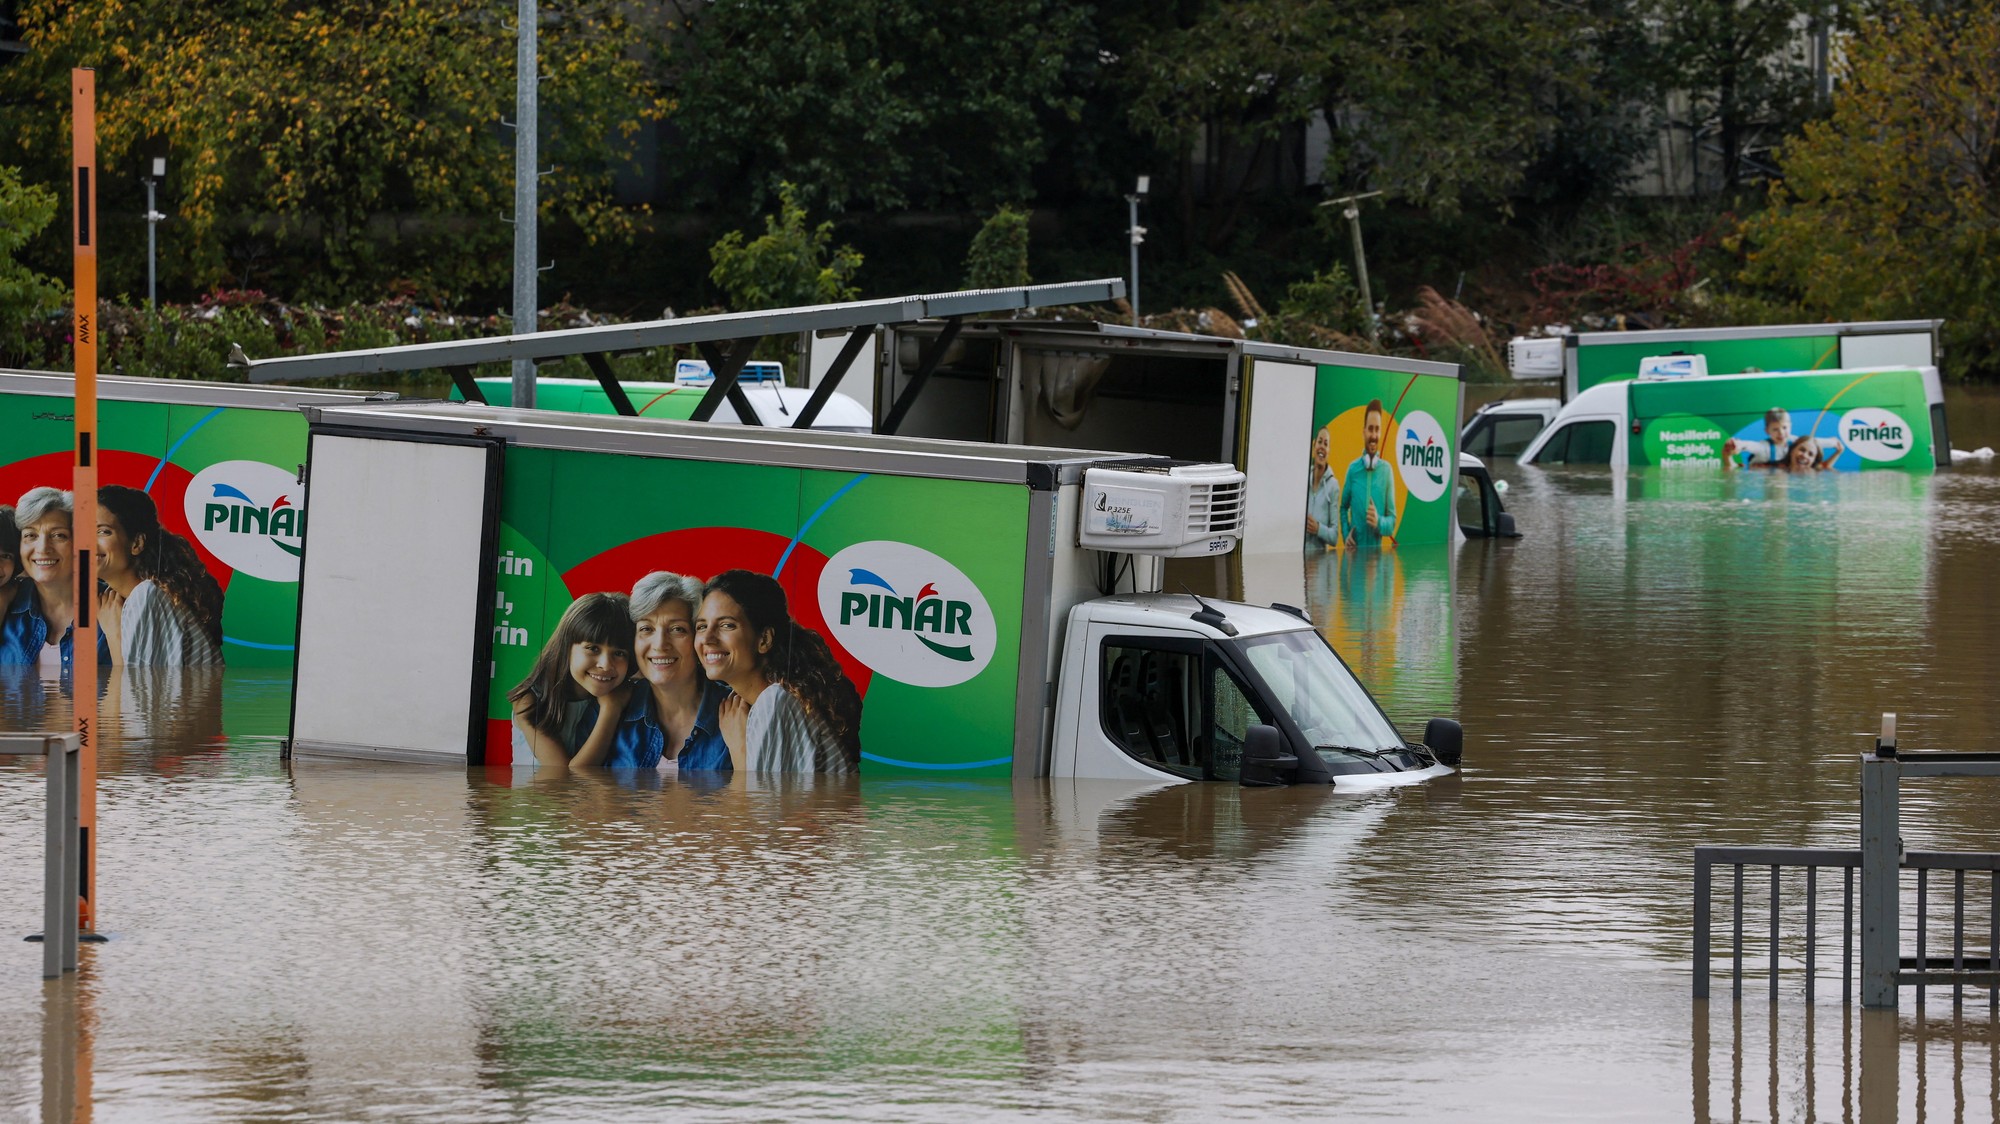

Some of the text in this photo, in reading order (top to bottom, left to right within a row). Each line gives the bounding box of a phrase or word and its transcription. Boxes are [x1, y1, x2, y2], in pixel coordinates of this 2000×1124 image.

[79, 314, 89, 344] AVAX
[1660, 429, 1721, 441] Nesillerin
[1849, 426, 1902, 441] PINAR
[1402, 444, 1443, 468] PINAR
[204, 503, 304, 537] PINA
[840, 591, 973, 636] PINAR
[79, 718, 89, 747] AVAX
